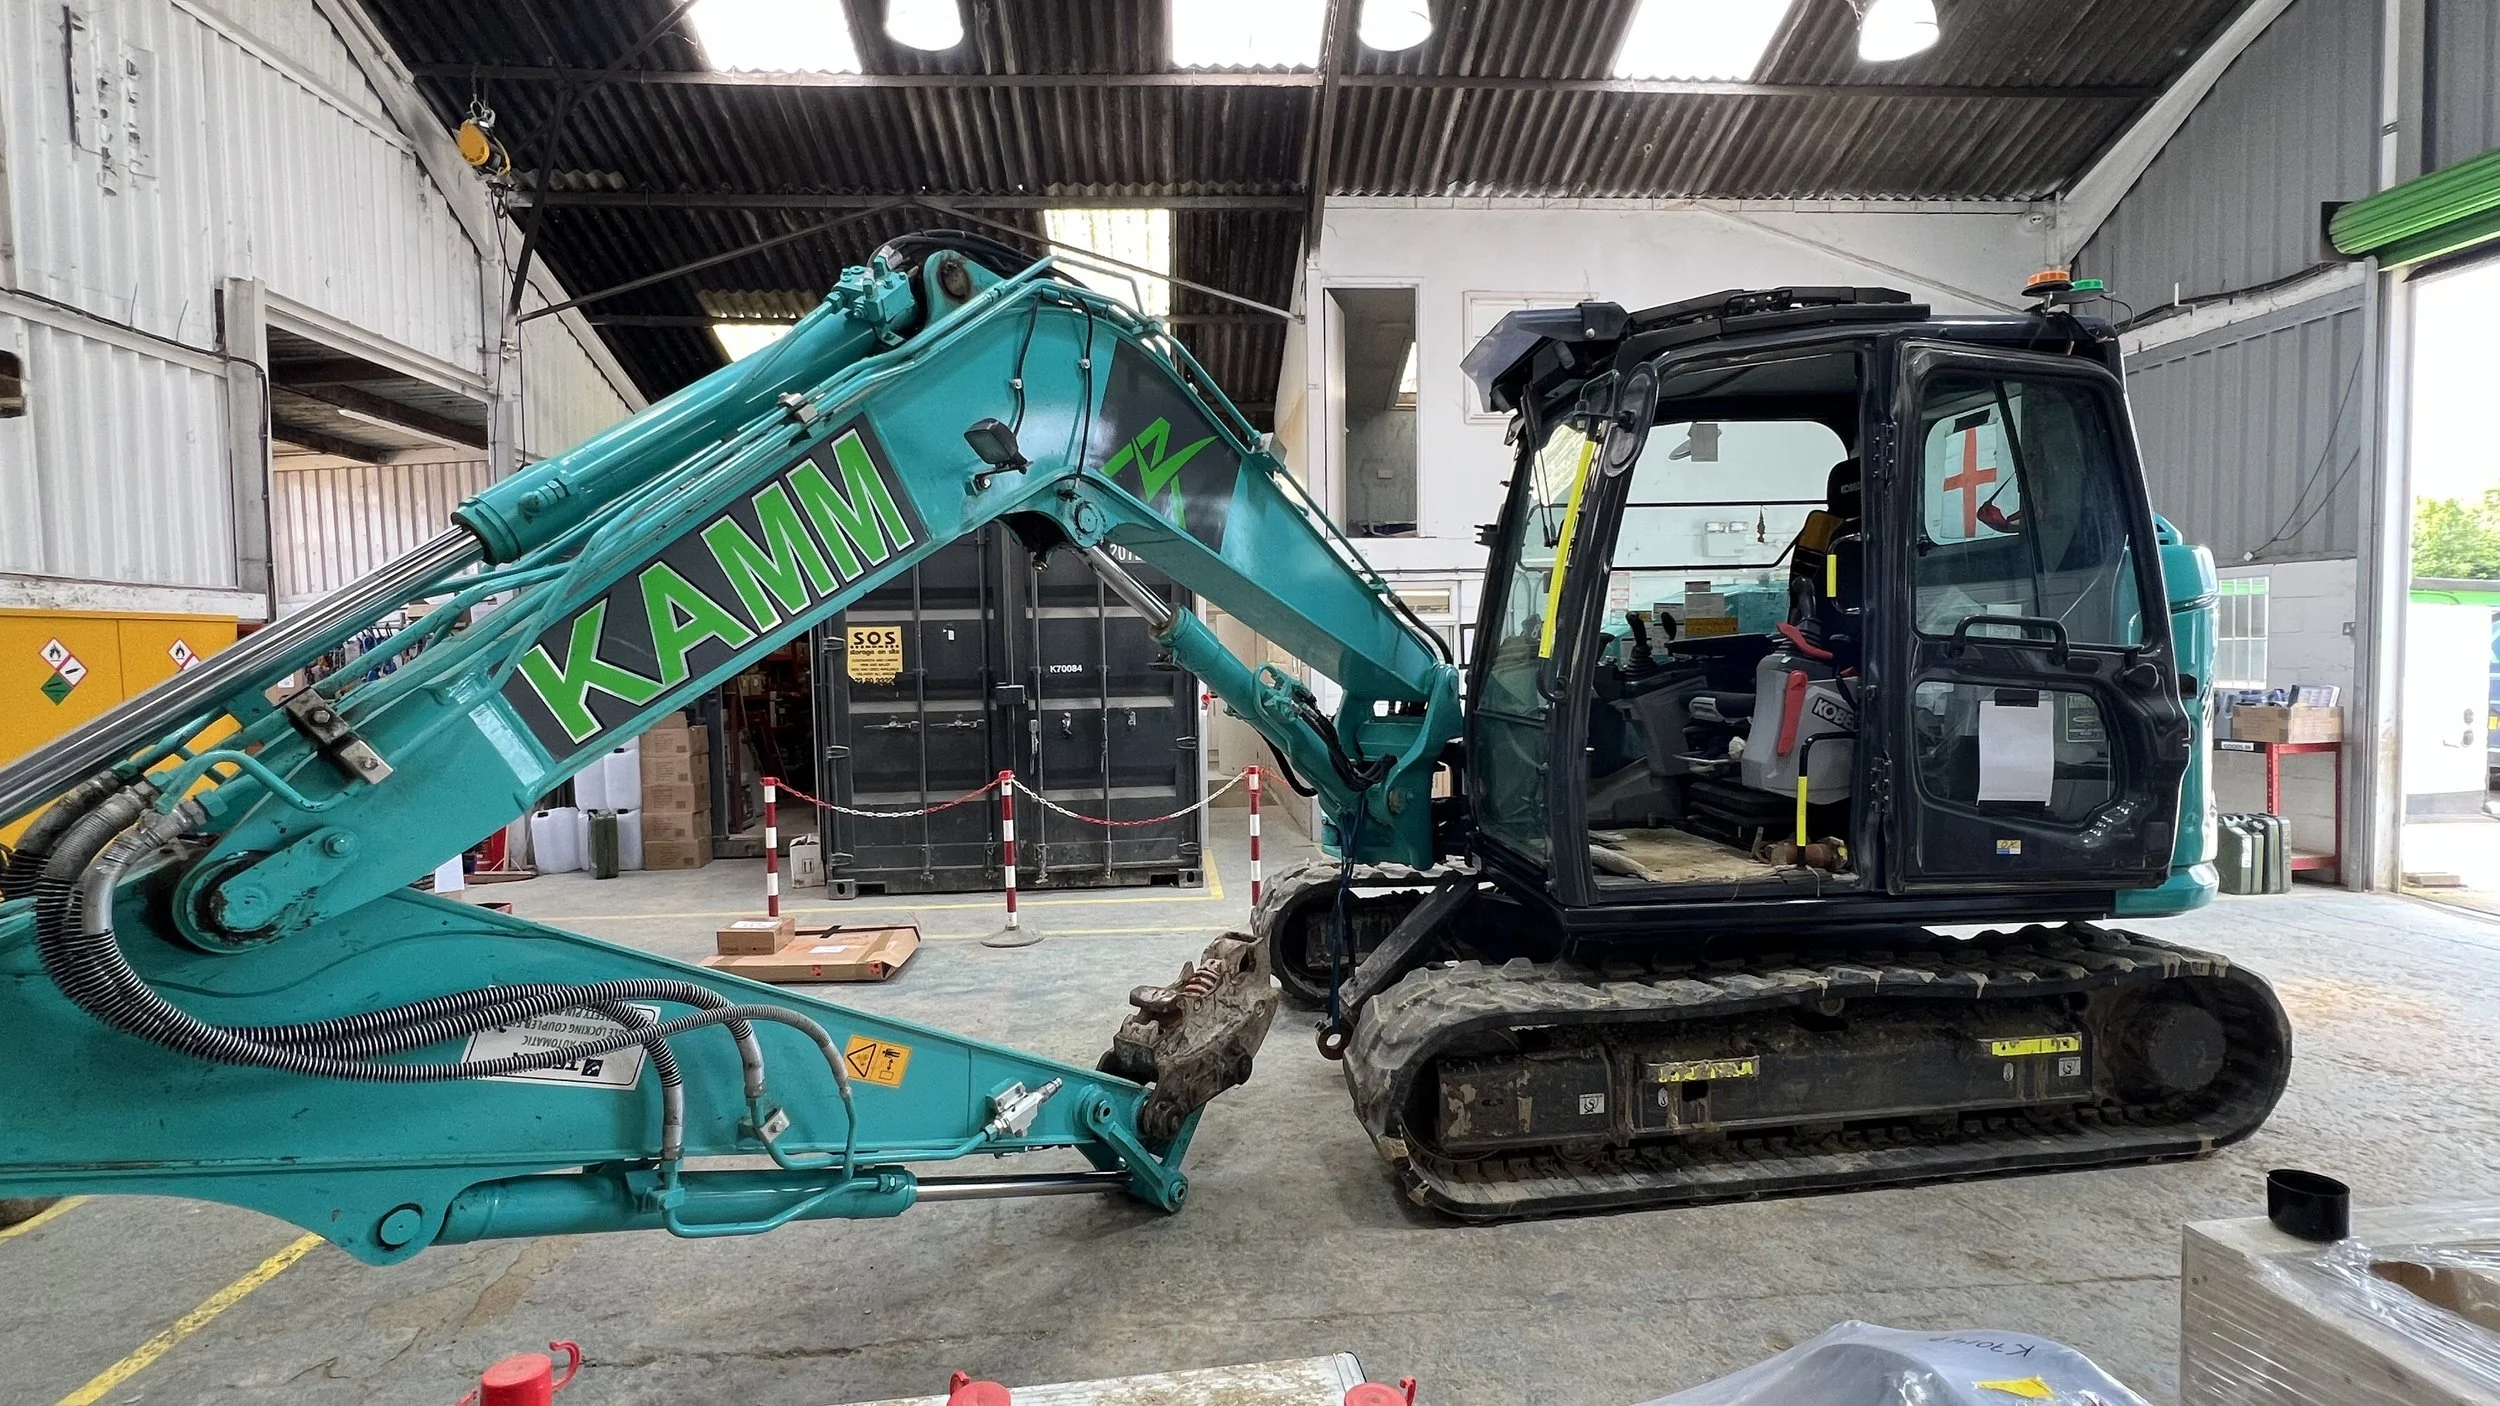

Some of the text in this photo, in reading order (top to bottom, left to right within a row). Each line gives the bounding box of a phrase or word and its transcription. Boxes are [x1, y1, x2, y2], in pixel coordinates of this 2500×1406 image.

[517, 428, 915, 744] KAMM
[853, 631, 896, 645] SOS
[1049, 664, 1083, 673] K70084
[569, 1025, 607, 1037] LOCKING
